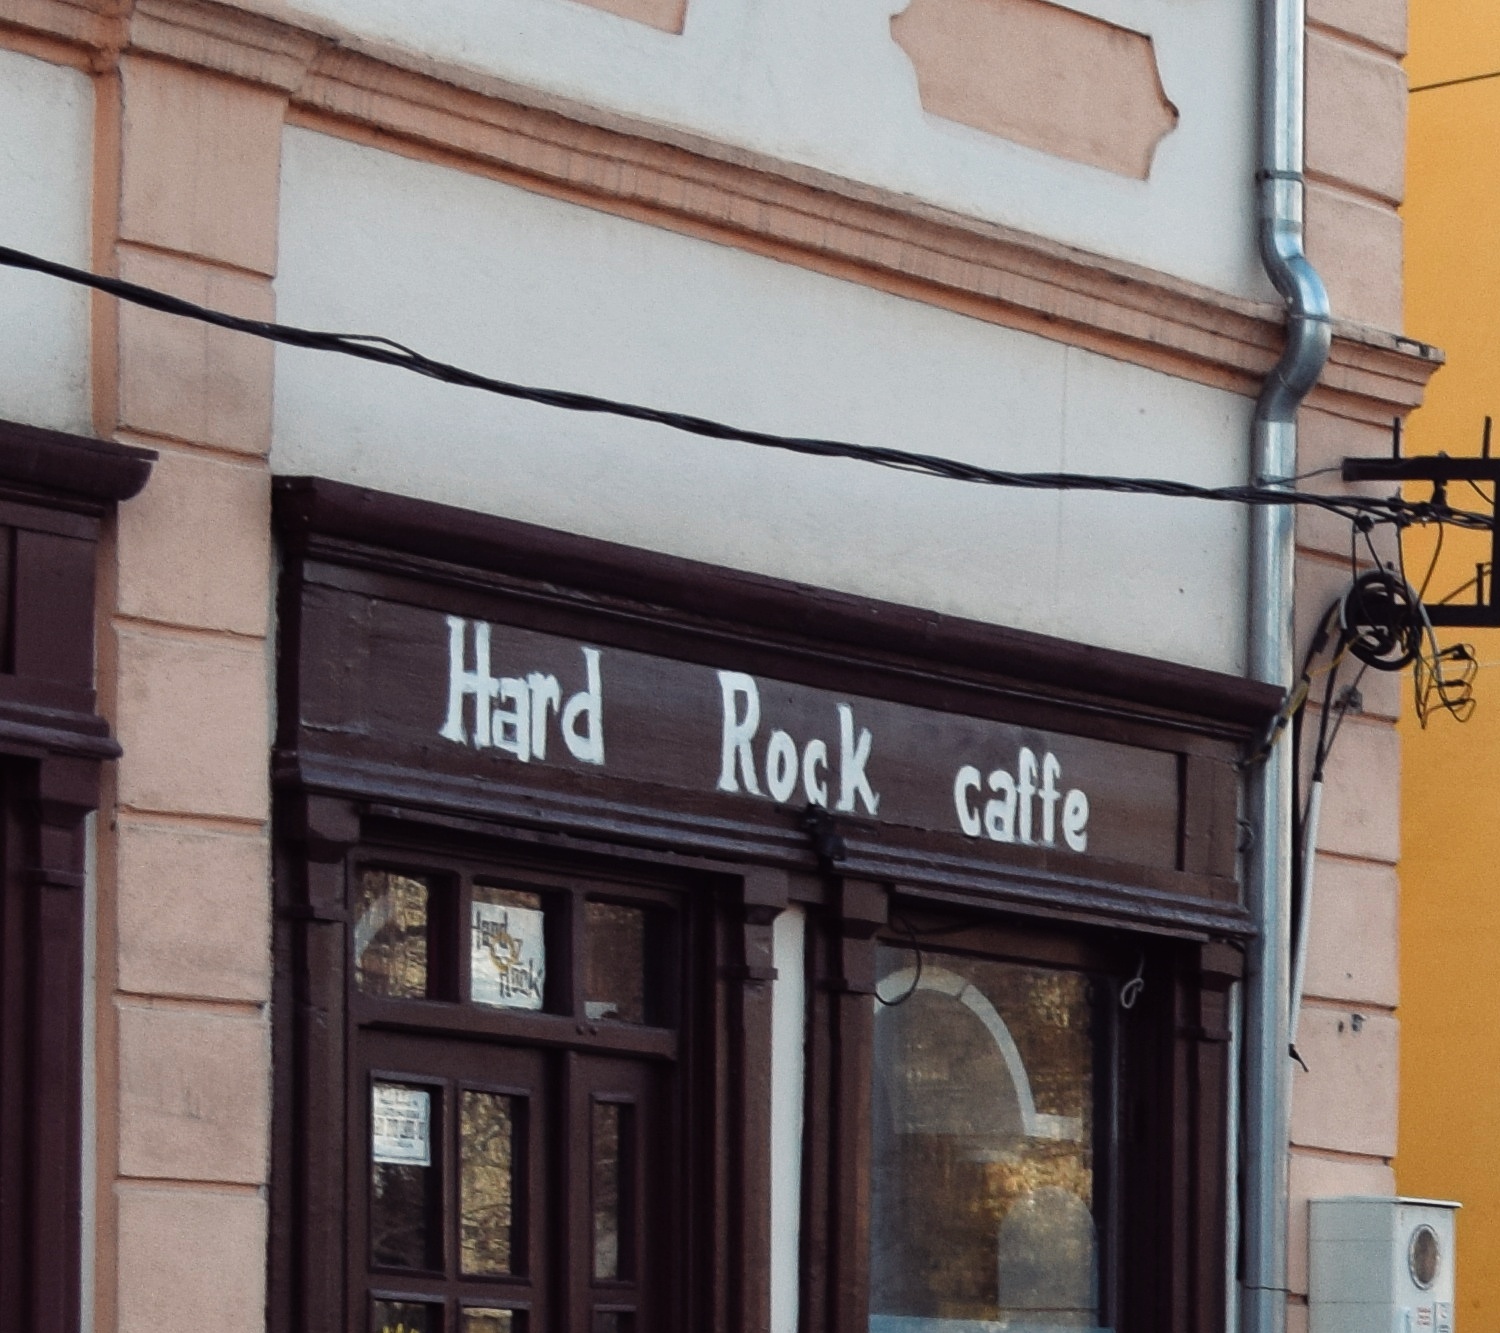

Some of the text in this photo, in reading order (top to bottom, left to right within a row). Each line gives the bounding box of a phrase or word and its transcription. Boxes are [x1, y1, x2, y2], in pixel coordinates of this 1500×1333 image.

[438, 614, 1090, 853] Hard Rock caffe
